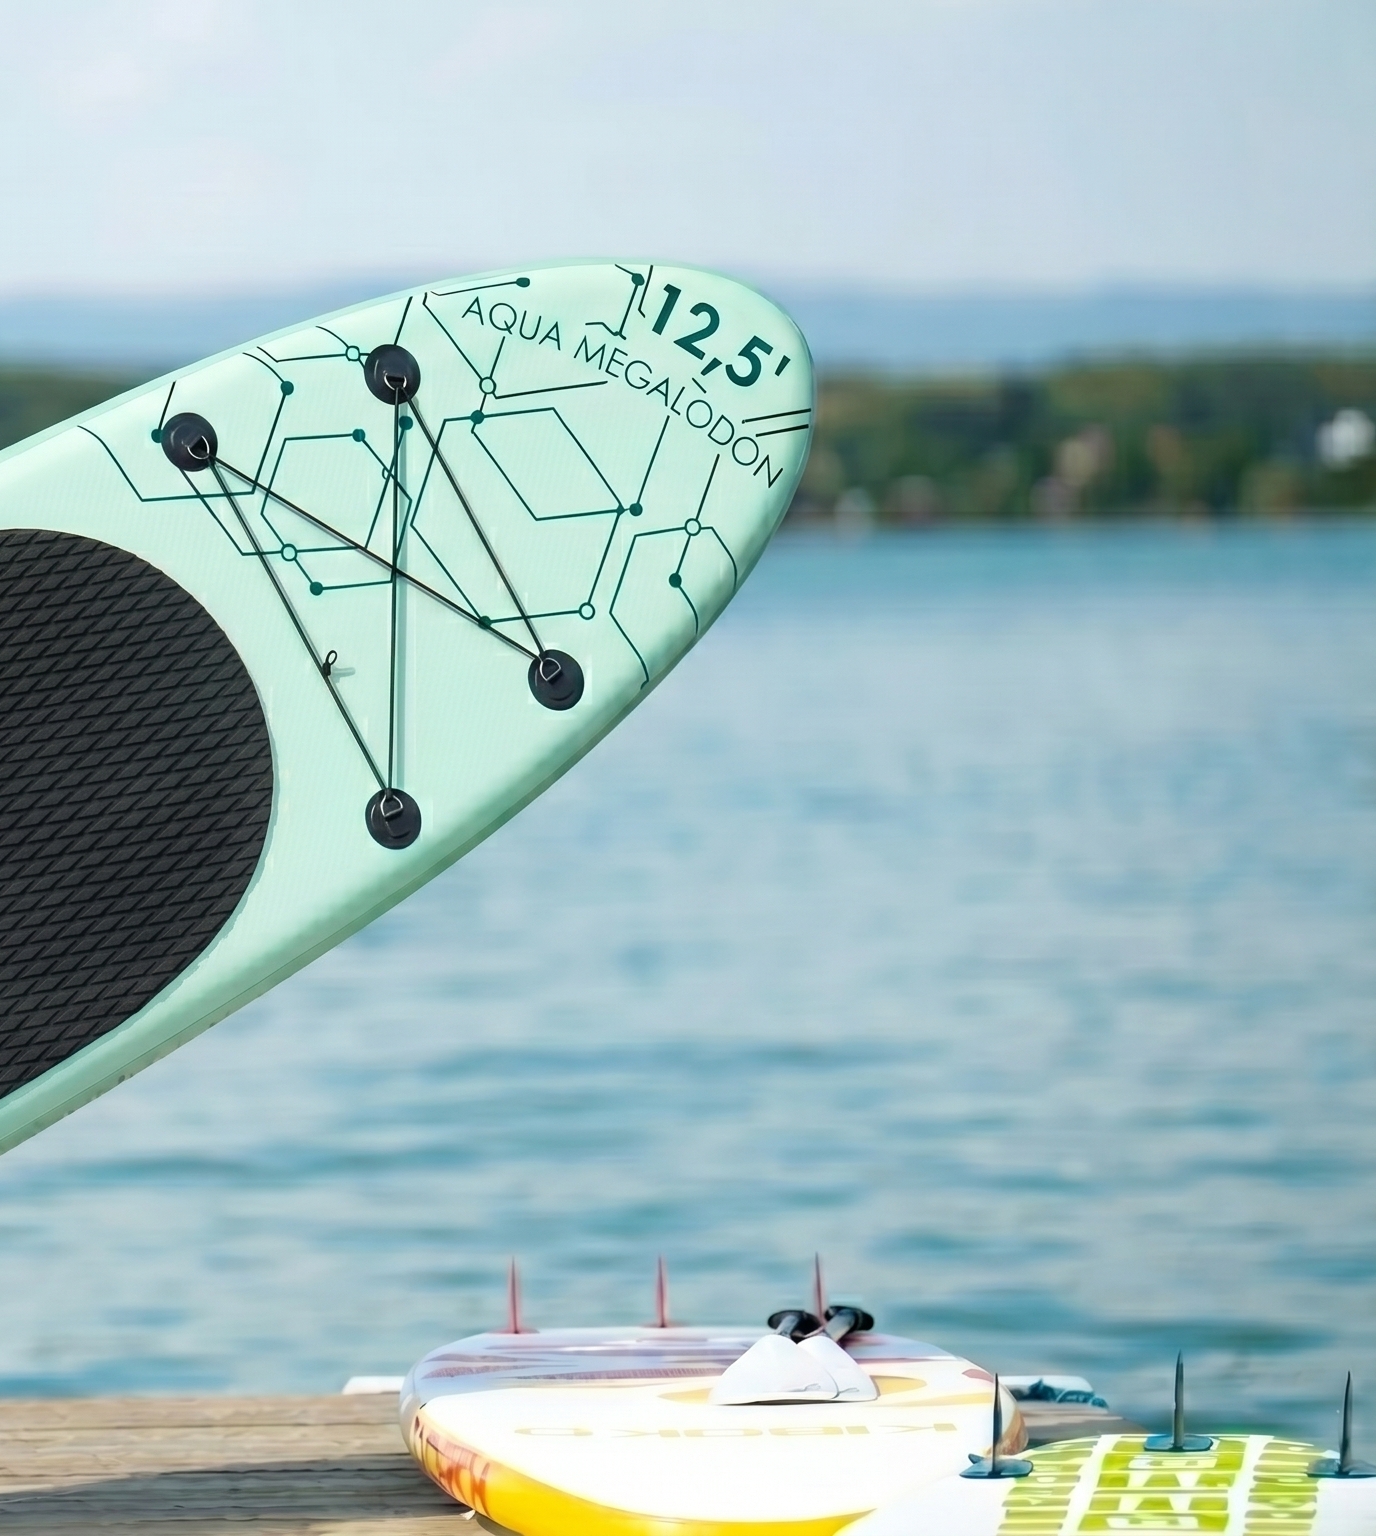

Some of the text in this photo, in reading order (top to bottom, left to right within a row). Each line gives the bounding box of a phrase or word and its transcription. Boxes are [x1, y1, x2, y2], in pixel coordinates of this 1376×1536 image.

[461, 296, 784, 488] AQUA MEGALODON
[651, 283, 791, 387] 12,5'
